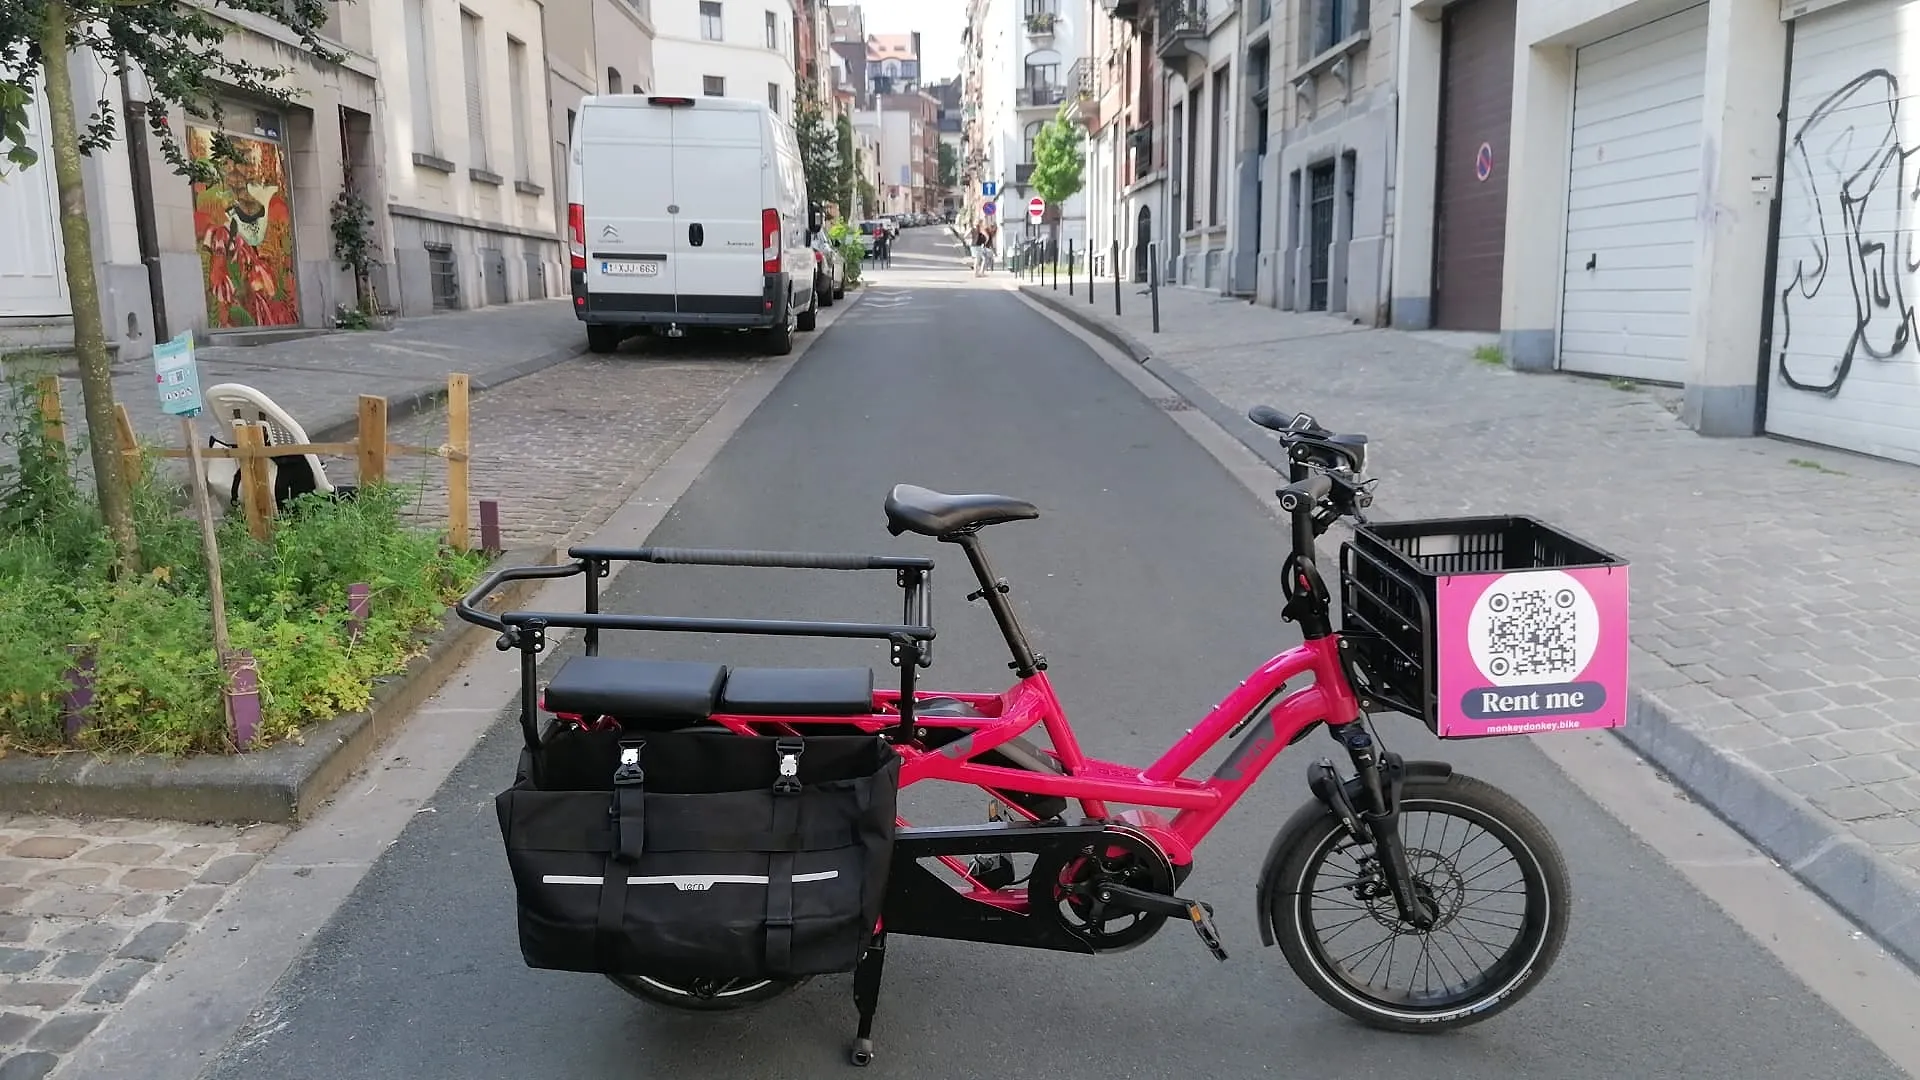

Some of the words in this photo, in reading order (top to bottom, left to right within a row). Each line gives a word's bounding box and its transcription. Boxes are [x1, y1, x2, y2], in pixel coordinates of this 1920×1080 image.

[1482, 691, 1540, 713] Rent
[1546, 690, 1584, 709] me
[1487, 720, 1580, 733] monkeydonkey.bike
